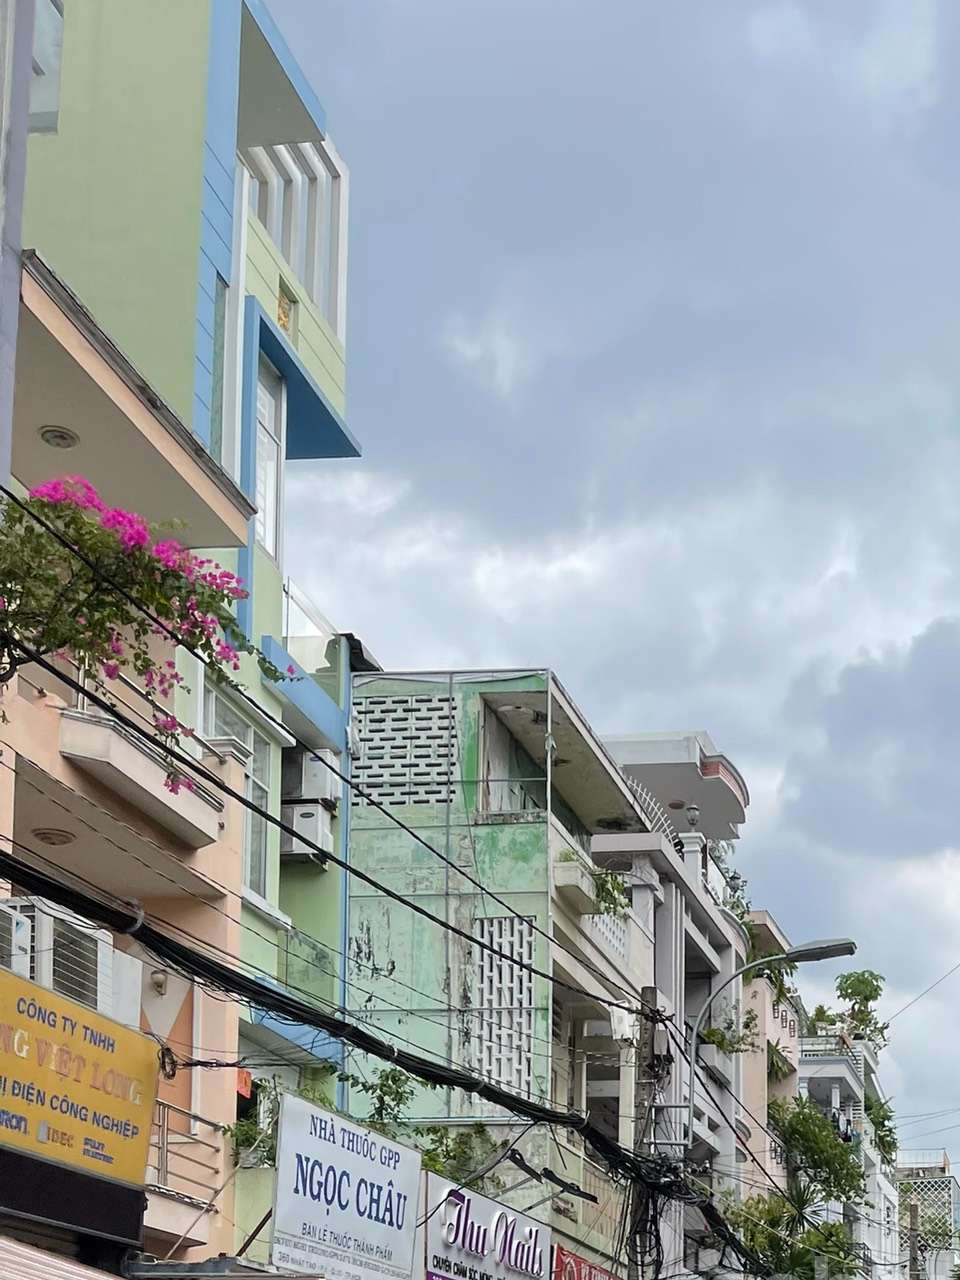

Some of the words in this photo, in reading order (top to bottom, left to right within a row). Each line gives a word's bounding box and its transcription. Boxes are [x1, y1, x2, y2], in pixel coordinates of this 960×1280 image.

[16, 997, 57, 1028] CÔNG
[62, 1015, 78, 1036] TY
[82, 1024, 115, 1053] TNHH
[35, 1036, 87, 1084] VIỆT
[89, 1062, 144, 1105] LONG
[12, 1079, 46, 1107] ĐIỆN
[50, 1094, 89, 1122] CÔNG
[92, 1111, 140, 1140] NGHIỆP
[309, 1114, 336, 1144] NHÀ
[340, 1127, 377, 1162] THUỐC
[379, 1146, 401, 1170] GPP
[293, 1153, 350, 1216] NGỌC
[356, 1178, 408, 1231] CHÂU
[329, 1230, 352, 1250] THUỐC
[440, 1189, 488, 1257] Thu
[490, 1211, 545, 1279] Nails
